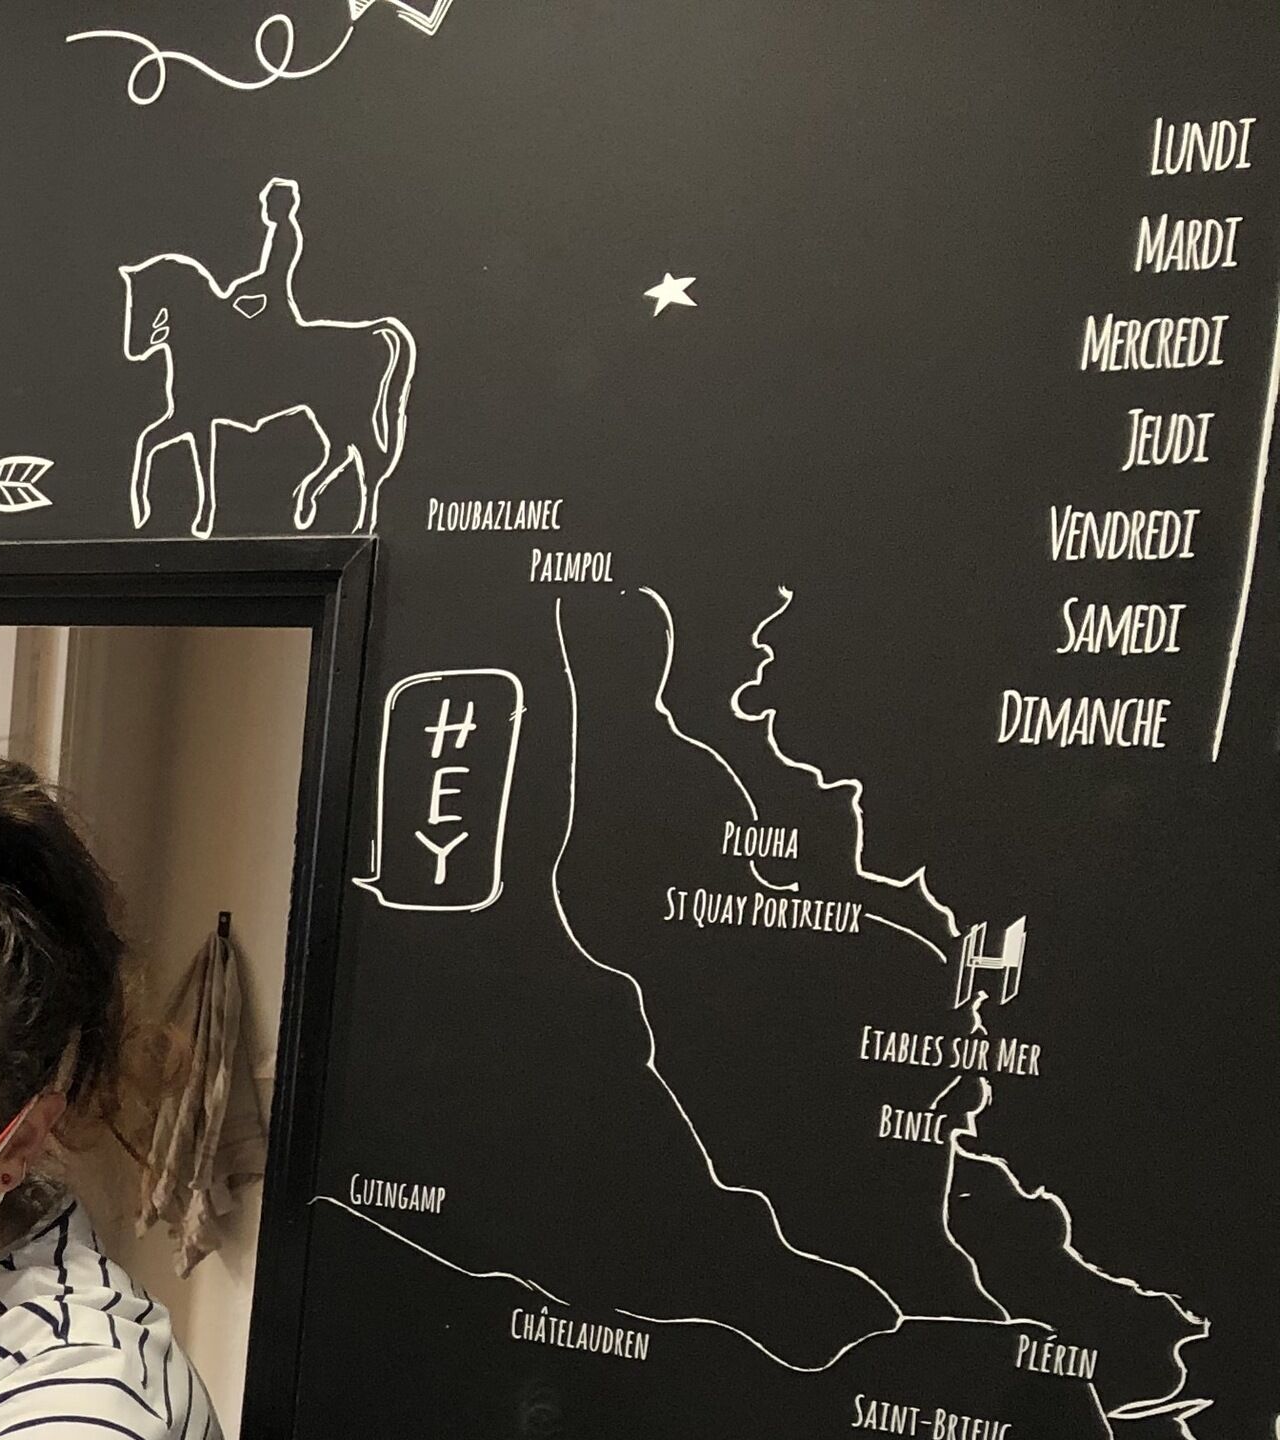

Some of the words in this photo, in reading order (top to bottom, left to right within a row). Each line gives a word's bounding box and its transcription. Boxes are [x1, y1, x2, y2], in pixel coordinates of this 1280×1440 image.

[1150, 116, 1257, 176] LUNDI
[1133, 213, 1244, 273] MARDI
[1080, 313, 1230, 373] MERCREDI
[1121, 408, 1215, 472] JEUDI
[427, 497, 564, 532] PLOUBAZLANEC
[1050, 504, 1201, 561] VENDREDI
[530, 548, 613, 582] PAIMPOL
[1056, 596, 1187, 656] SAMEDI
[997, 689, 1172, 748] DIMANCHE
[722, 820, 799, 860] PLOUHA
[693, 888, 747, 928] QUAY
[752, 892, 864, 934] PORTRIEUX
[860, 1025, 944, 1068] ETABLES
[950, 1038, 989, 1072] SUR
[997, 1037, 1042, 1076] MER
[878, 1104, 947, 1146] BINIC
[349, 1172, 446, 1215] GUINGAMP
[510, 1305, 650, 1361] CHÂTELAUDREN
[1015, 1333, 1098, 1381] PLÉRIN
